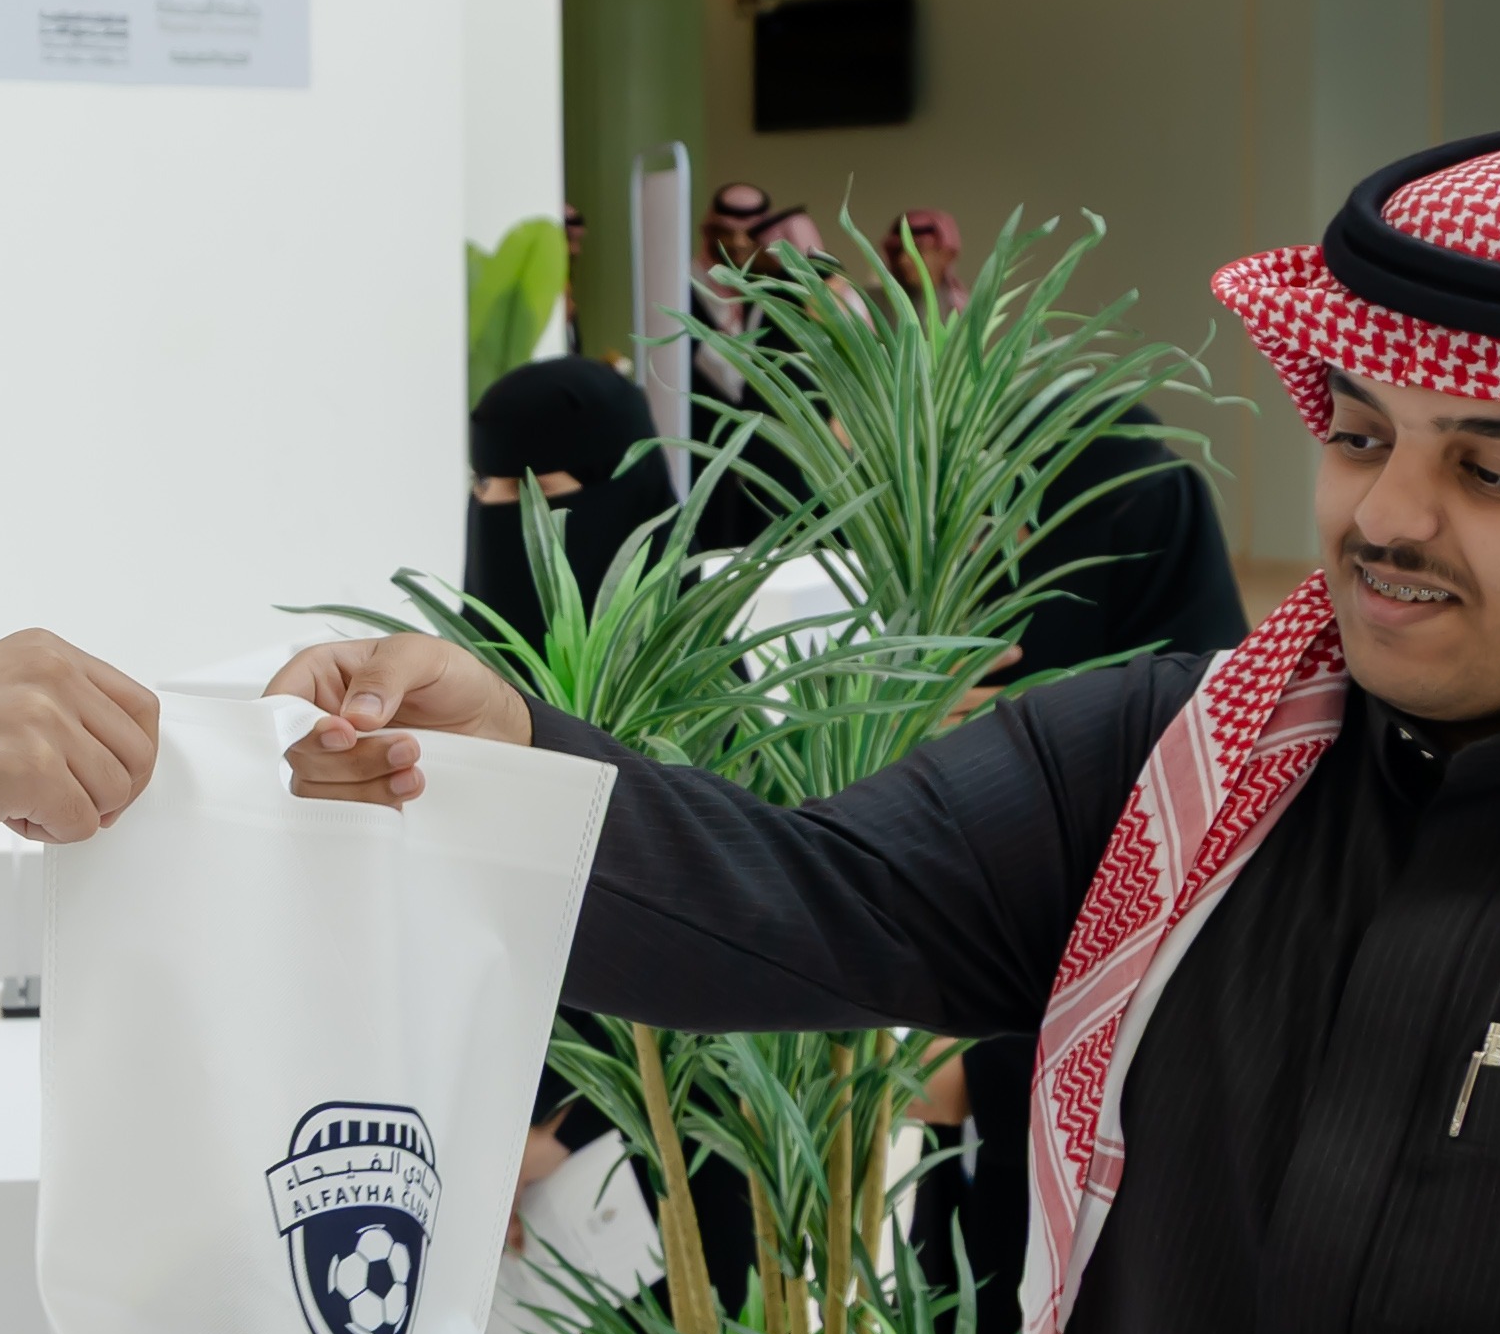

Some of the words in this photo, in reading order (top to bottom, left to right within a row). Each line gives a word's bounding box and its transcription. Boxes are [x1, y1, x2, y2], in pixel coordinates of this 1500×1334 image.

[286, 1150, 400, 1191] الفيحاء
[294, 1184, 395, 1219] ALFAYHA
[401, 1189, 429, 1227] CLUB
